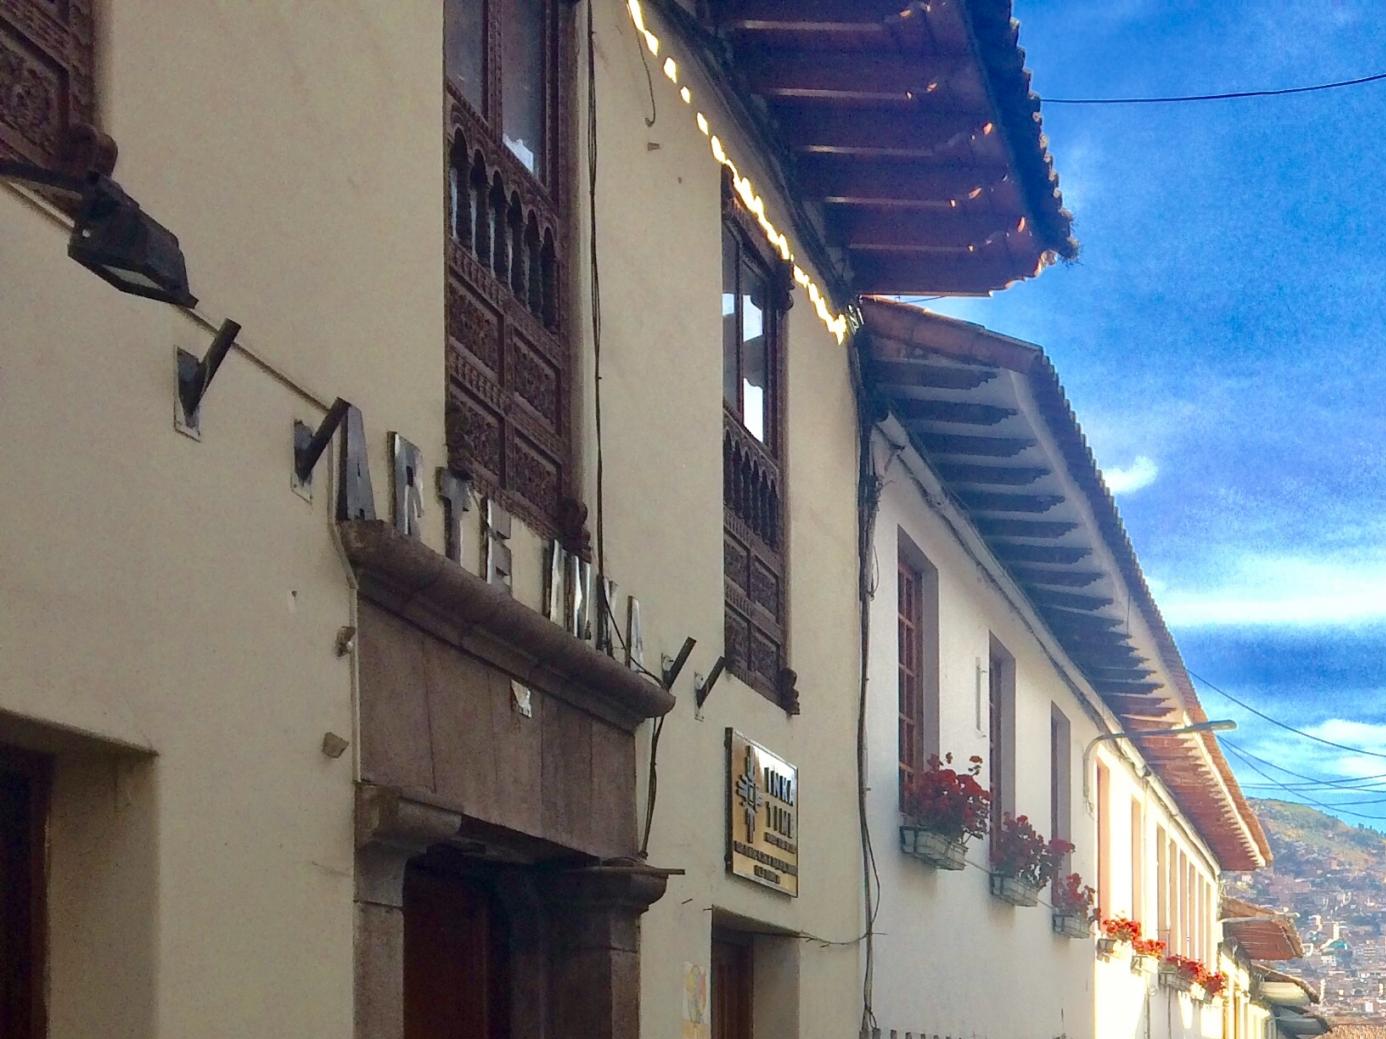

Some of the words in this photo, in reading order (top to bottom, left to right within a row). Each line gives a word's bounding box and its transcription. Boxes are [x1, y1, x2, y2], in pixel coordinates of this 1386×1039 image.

[336, 400, 513, 600] ARTE
[764, 767, 795, 807] INKA
[765, 801, 794, 840] TIME
